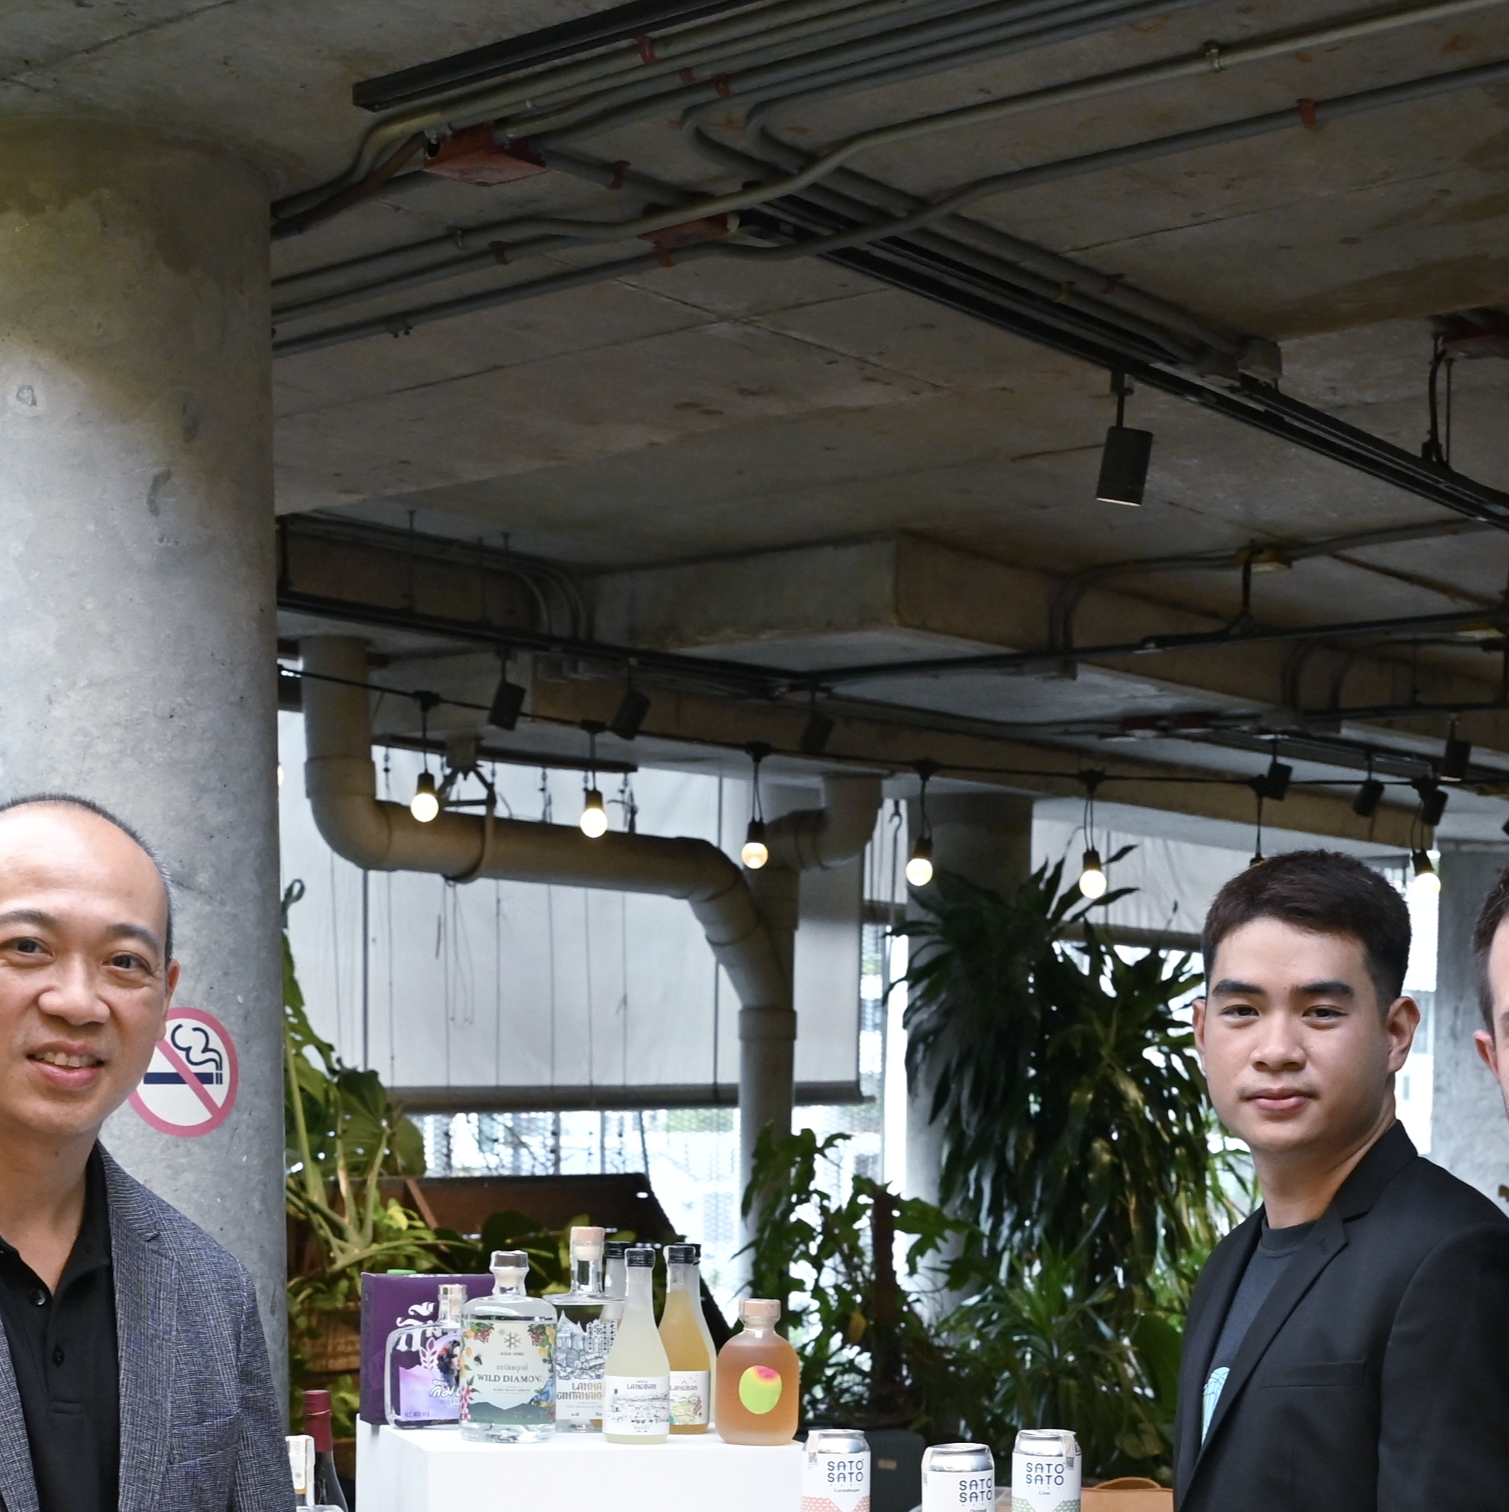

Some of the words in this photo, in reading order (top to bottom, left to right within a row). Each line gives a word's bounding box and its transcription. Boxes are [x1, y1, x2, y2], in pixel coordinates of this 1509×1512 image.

[477, 1373, 501, 1382] WILD
[827, 1460, 864, 1471] SATO
[1026, 1462, 1064, 1474] SATO
[827, 1472, 864, 1482] SATO
[1025, 1474, 1064, 1485] SATO
